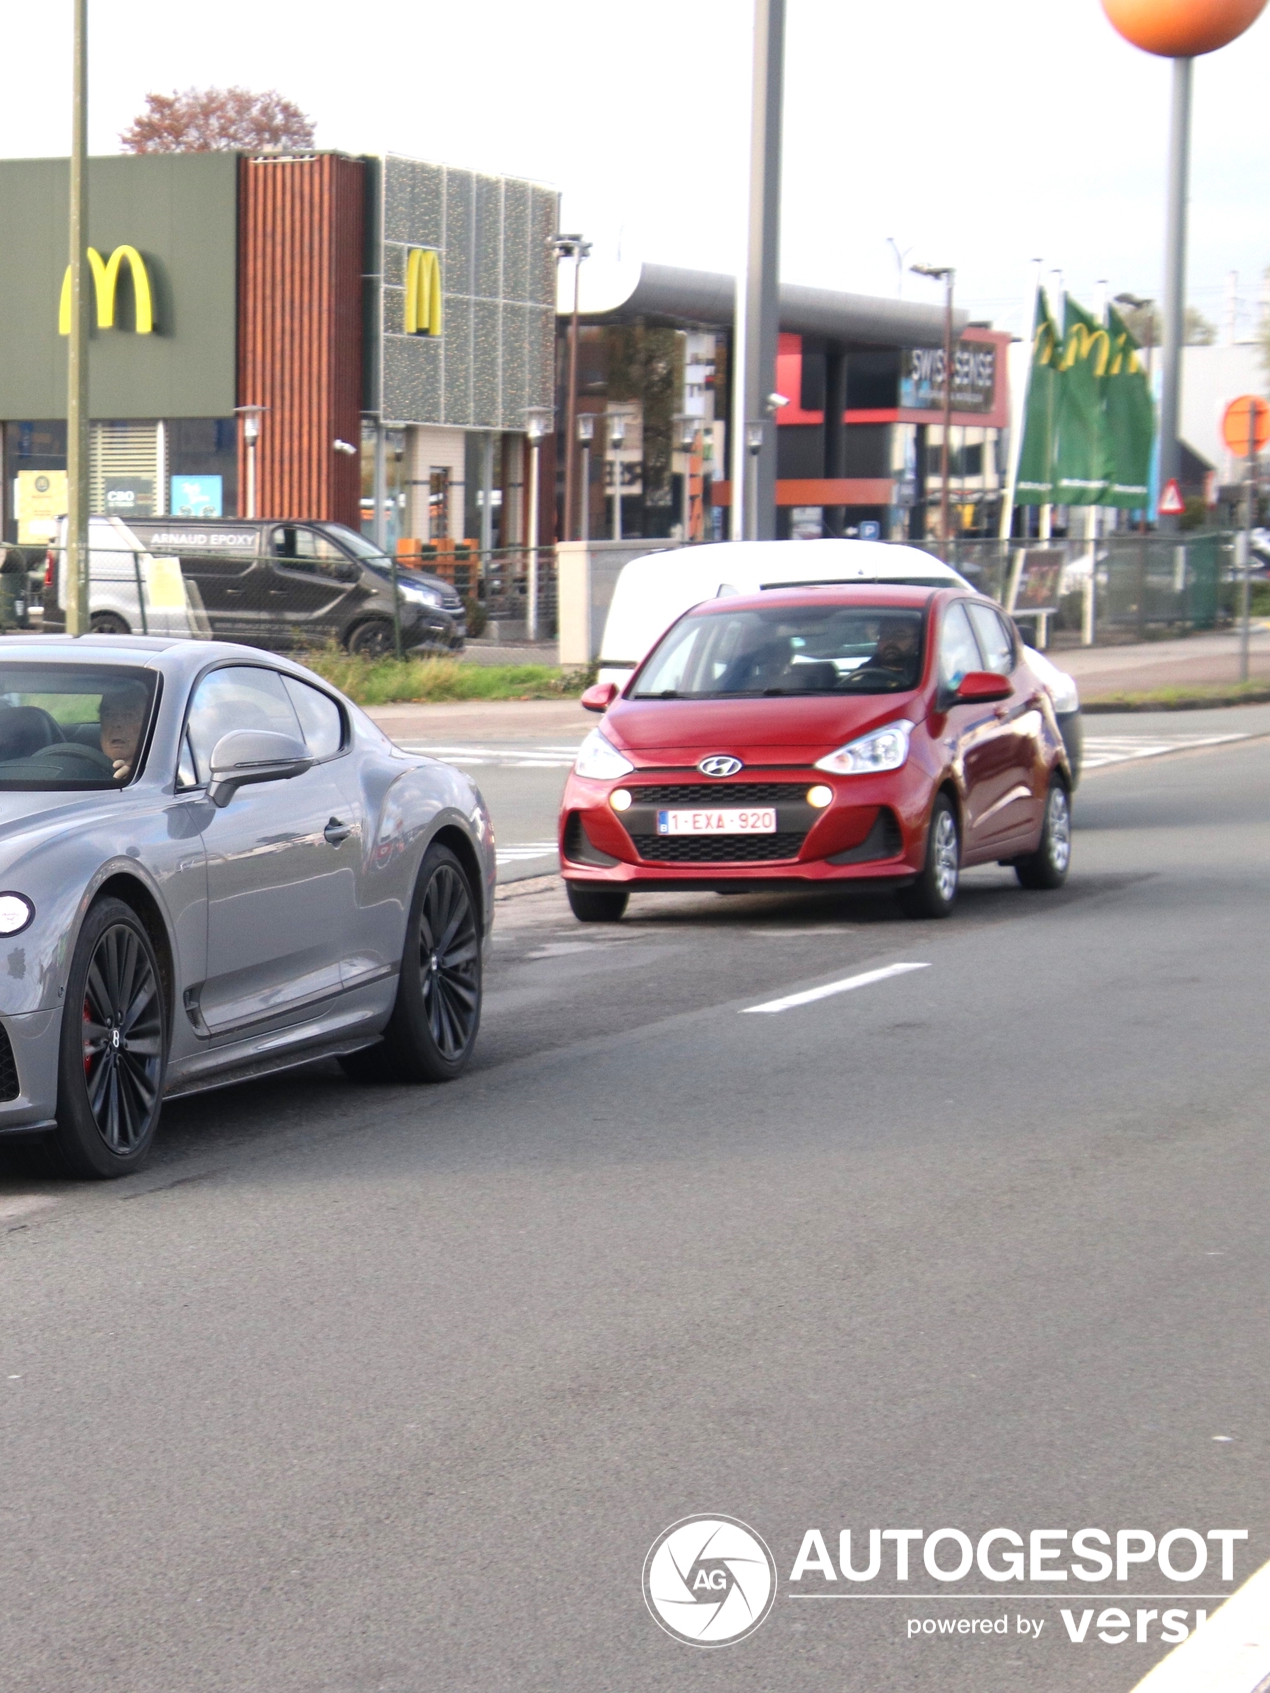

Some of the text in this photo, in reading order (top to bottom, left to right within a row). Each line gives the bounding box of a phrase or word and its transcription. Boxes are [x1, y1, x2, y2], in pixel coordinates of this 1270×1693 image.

[911, 348, 949, 382] SWIS
[151, 533, 255, 545] ARNAUD EPOXY
